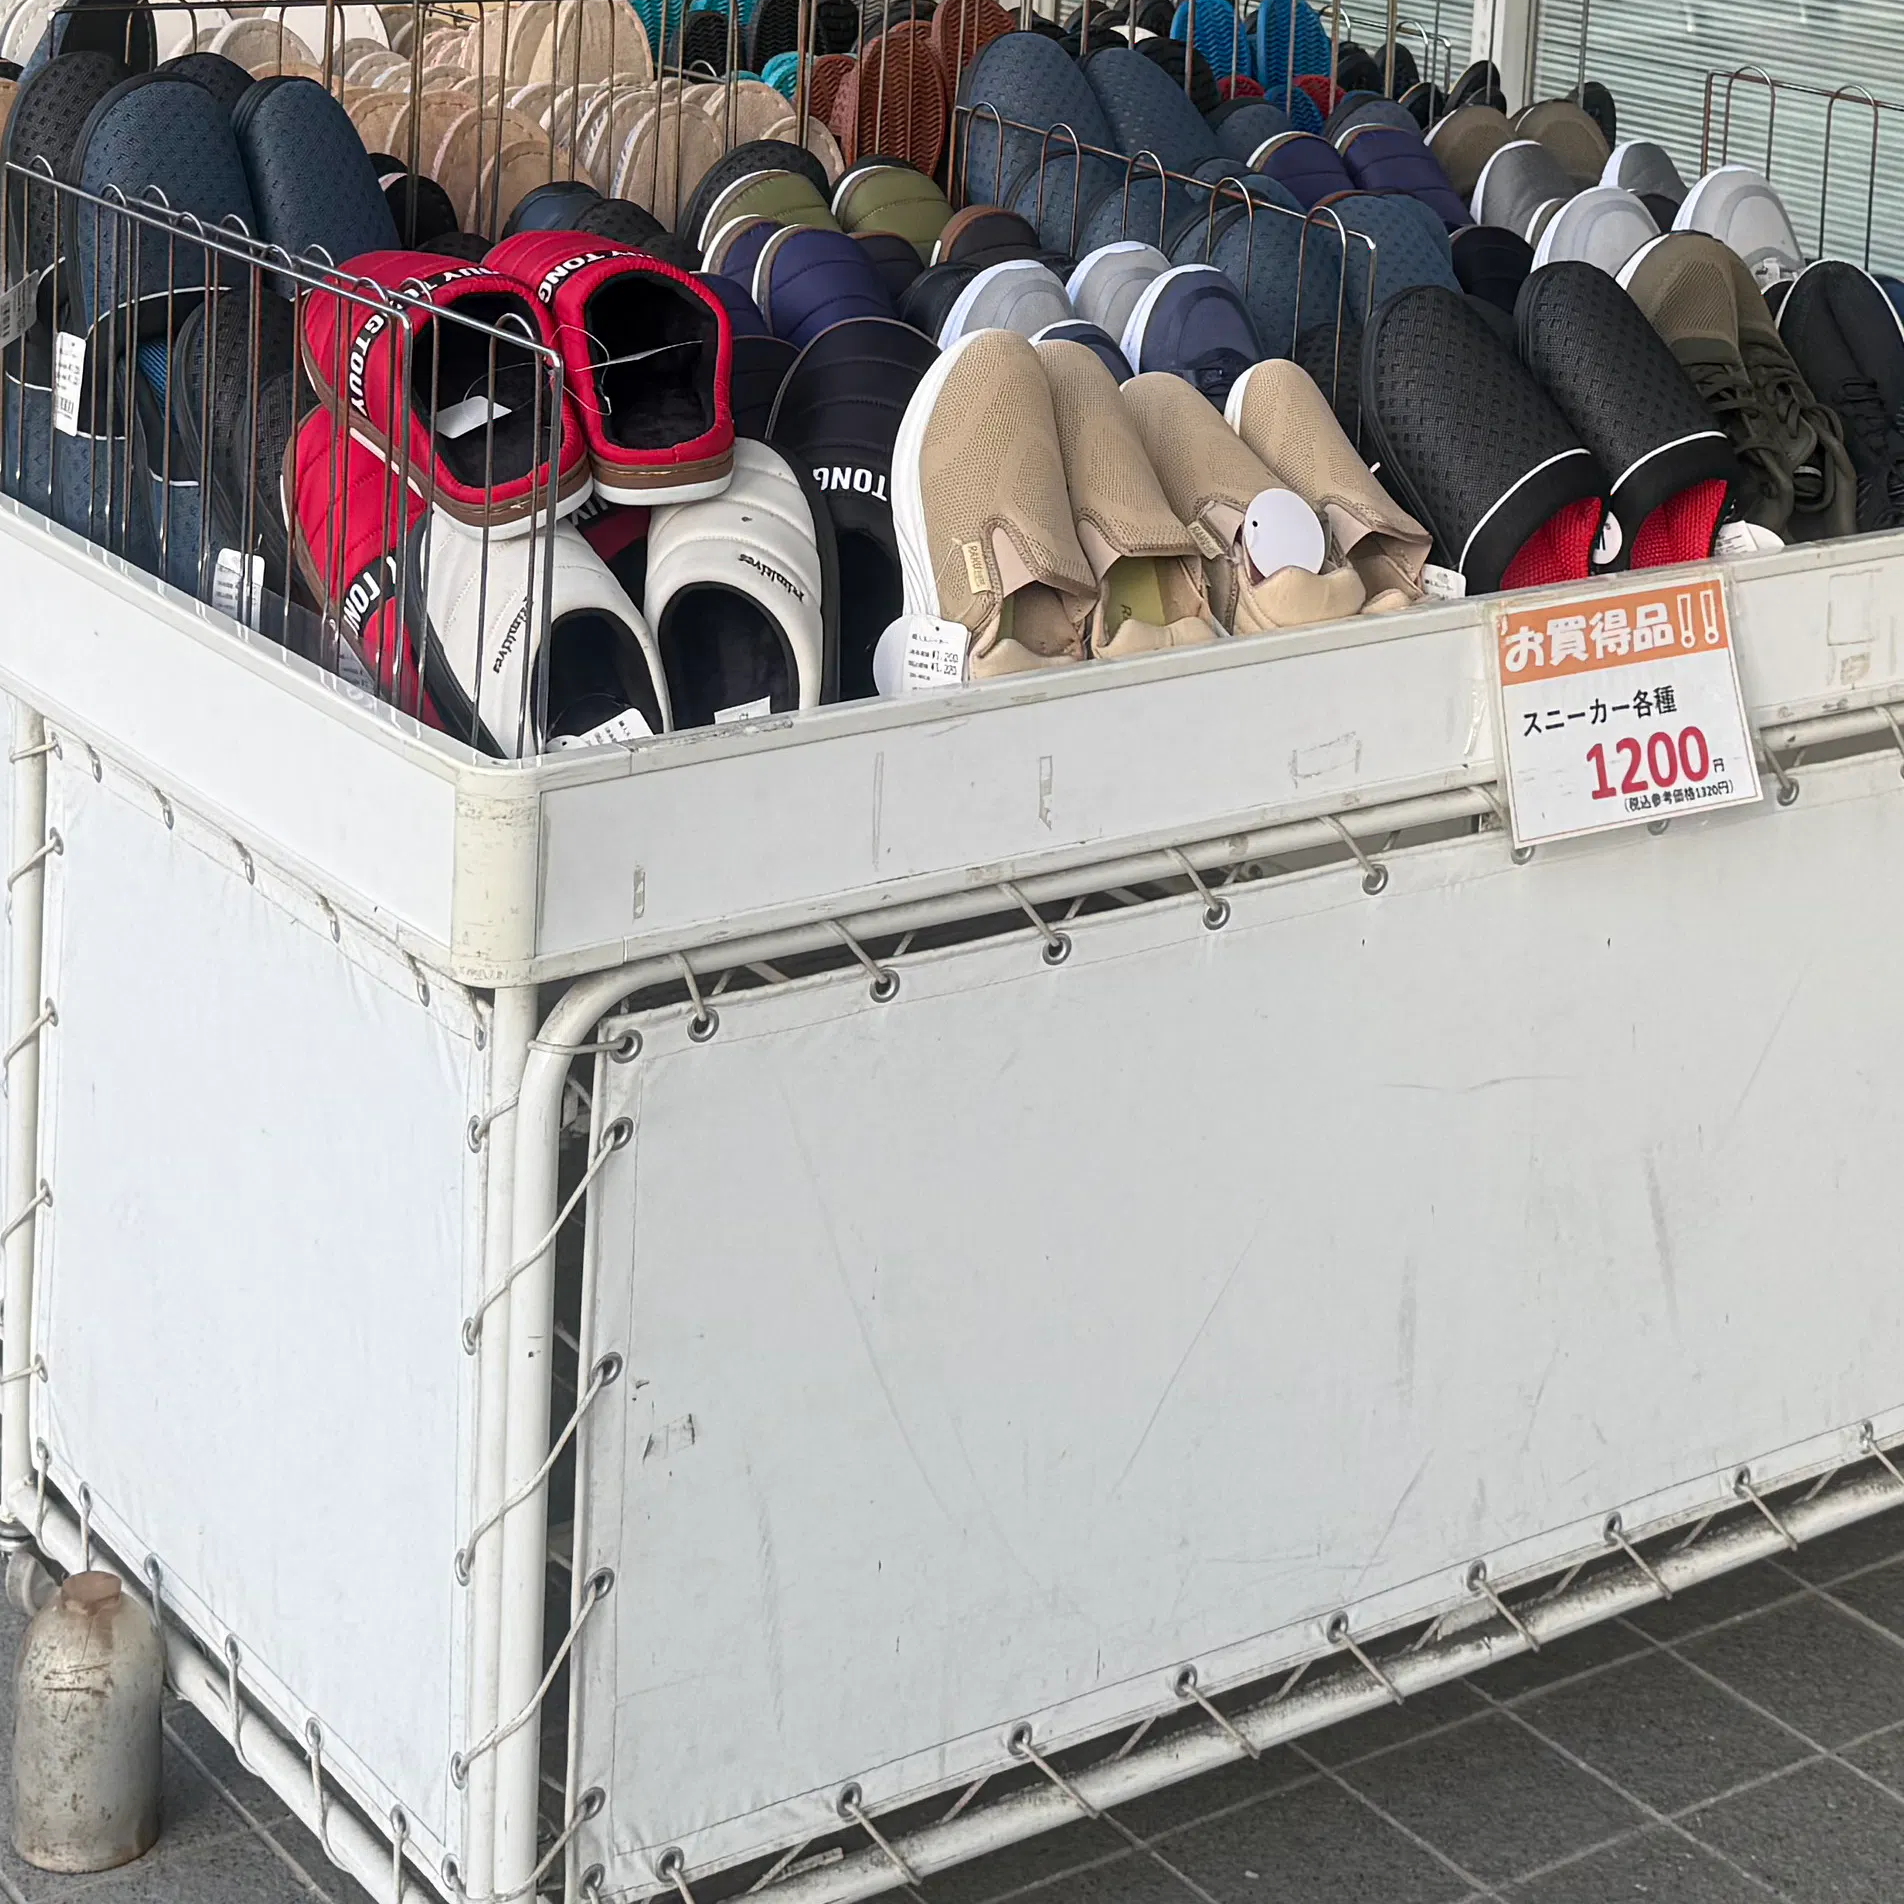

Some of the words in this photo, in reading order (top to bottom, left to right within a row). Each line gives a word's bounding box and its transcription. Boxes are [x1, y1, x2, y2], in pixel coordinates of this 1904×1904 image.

[537, 252, 606, 304] TONG
[1523, 685, 1678, 737] スニーカー各種
